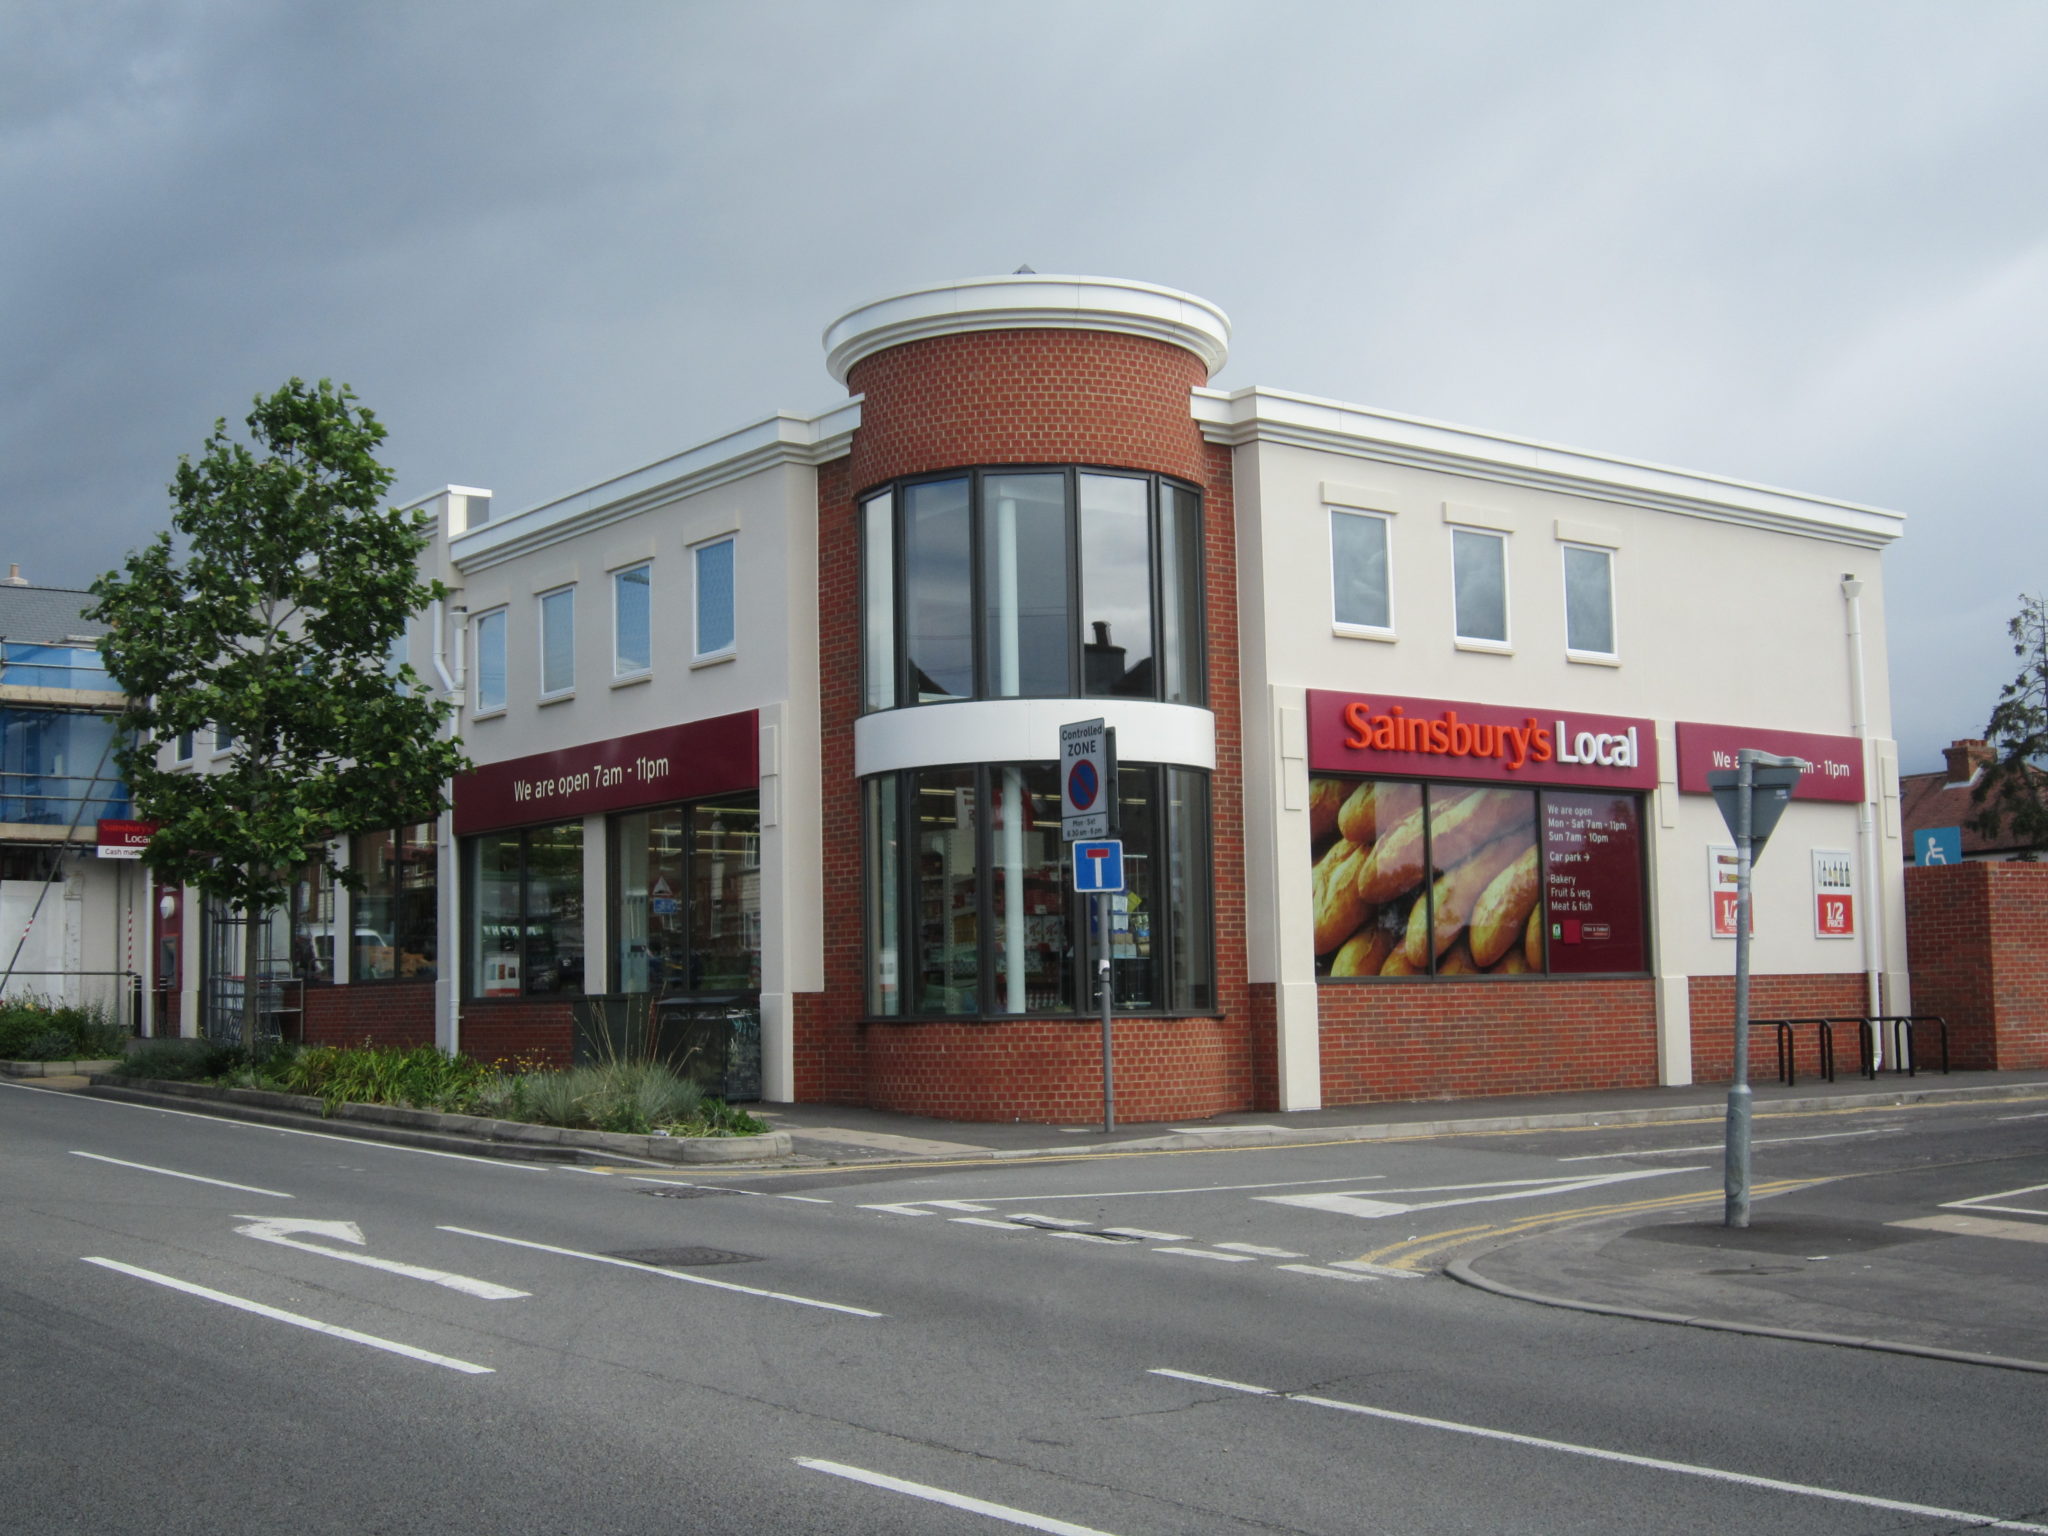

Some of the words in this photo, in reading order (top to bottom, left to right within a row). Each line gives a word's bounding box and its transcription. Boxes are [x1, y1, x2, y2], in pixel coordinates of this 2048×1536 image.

[1062, 725, 1102, 741] Controlled
[1345, 702, 1551, 770] Sainsbury's
[1555, 720, 1637, 767] Local
[1068, 740, 1096, 757] ZONE
[1713, 751, 1731, 768] We
[1824, 760, 1850, 779] 11pm
[514, 780, 531, 802] We
[535, 779, 554, 798] are
[558, 772, 590, 797] open
[593, 765, 622, 788] 7am
[636, 756, 669, 783] 11pm
[1548, 804, 1559, 814] We
[1561, 807, 1573, 815] are
[1575, 808, 1592, 816] open
[1548, 818, 1564, 828] Mon
[1571, 818, 1584, 829] Sat
[1586, 819, 1603, 830] 7am
[1609, 821, 1627, 831] 11pm
[1549, 832, 1563, 842] Sun
[1565, 832, 1581, 842] 7am
[1589, 833, 1608, 844] 10pm
[105, 848, 120, 856] Cash
[1550, 851, 1562, 862] Car
[1565, 853, 1581, 863] park
[1550, 874, 1576, 886] Bakery
[1551, 887, 1568, 897] Fruit
[1570, 888, 1575, 897] &
[1577, 889, 1590, 899] veg
[1551, 901, 1569, 911] Meat
[1572, 901, 1577, 911] &
[1579, 901, 1592, 911] fish
[1826, 902, 1844, 920] 1/2
[1827, 919, 1845, 927] PRICE
